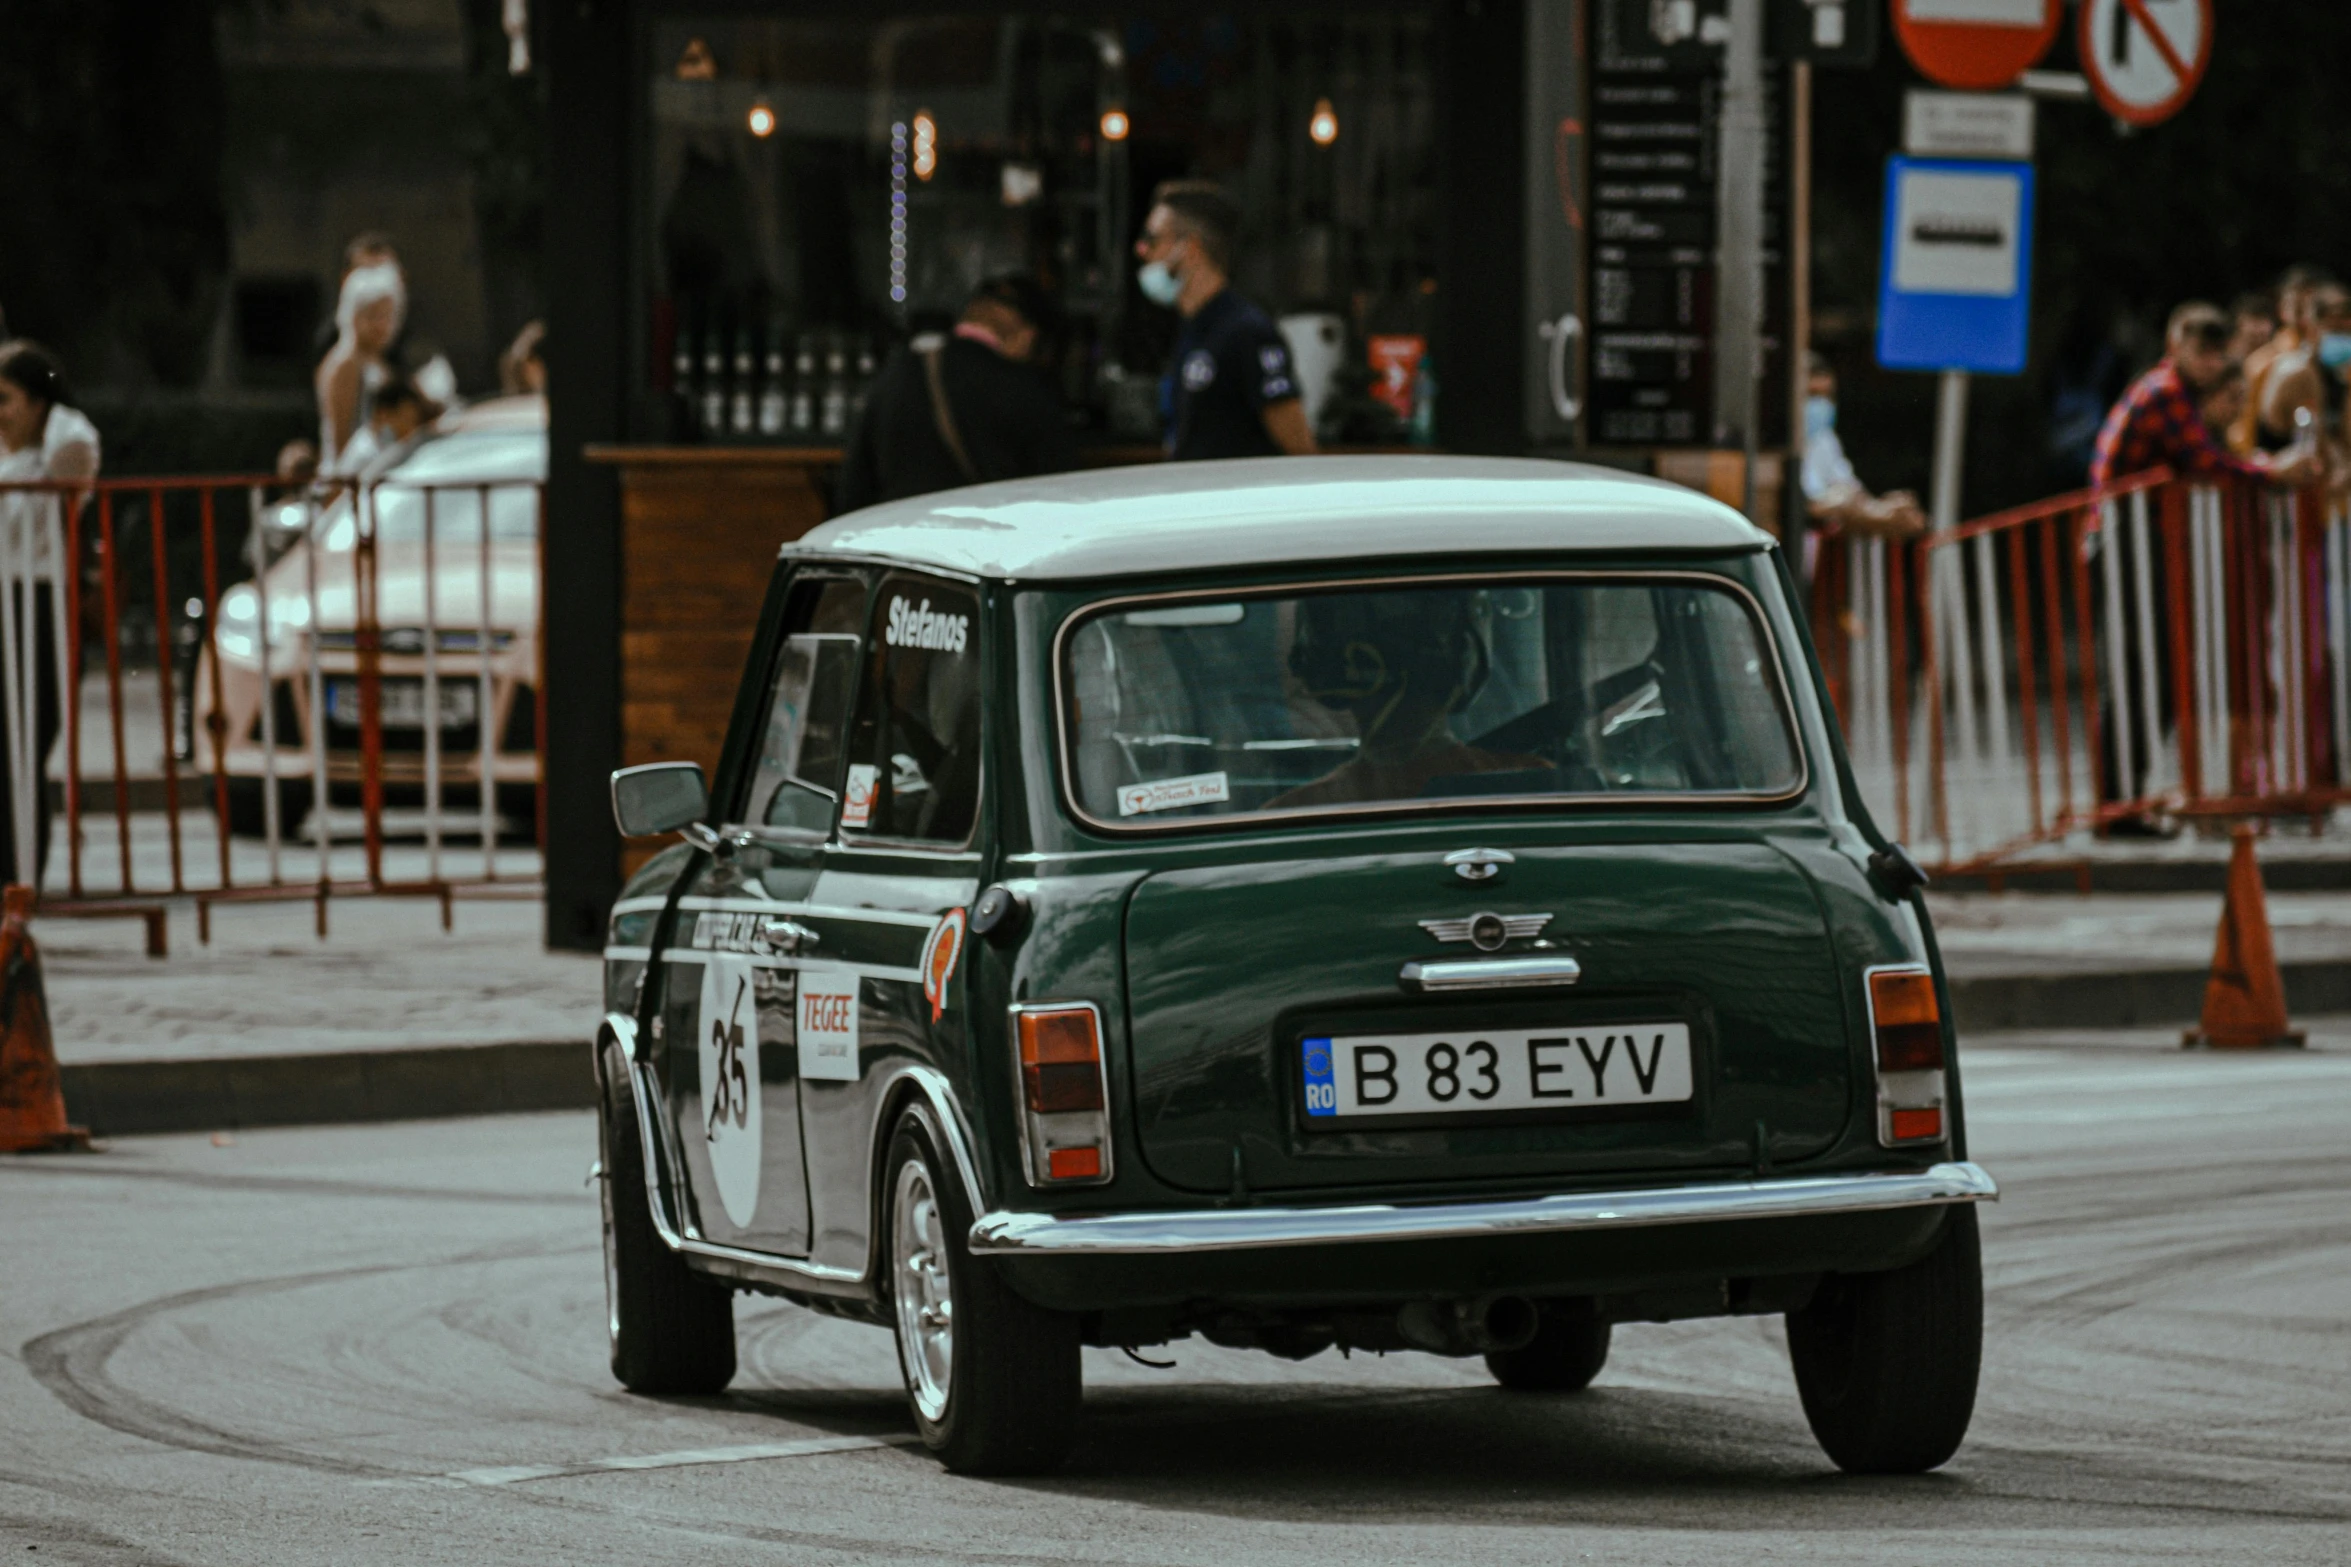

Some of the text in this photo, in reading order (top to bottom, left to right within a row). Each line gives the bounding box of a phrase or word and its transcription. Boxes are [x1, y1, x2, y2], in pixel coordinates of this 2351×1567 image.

[886, 595, 968, 652] Stefanos
[803, 993, 853, 1032] TEGEE
[1353, 1035, 1665, 1106] B 83 EYV
[1306, 1083, 1334, 1110] RO
